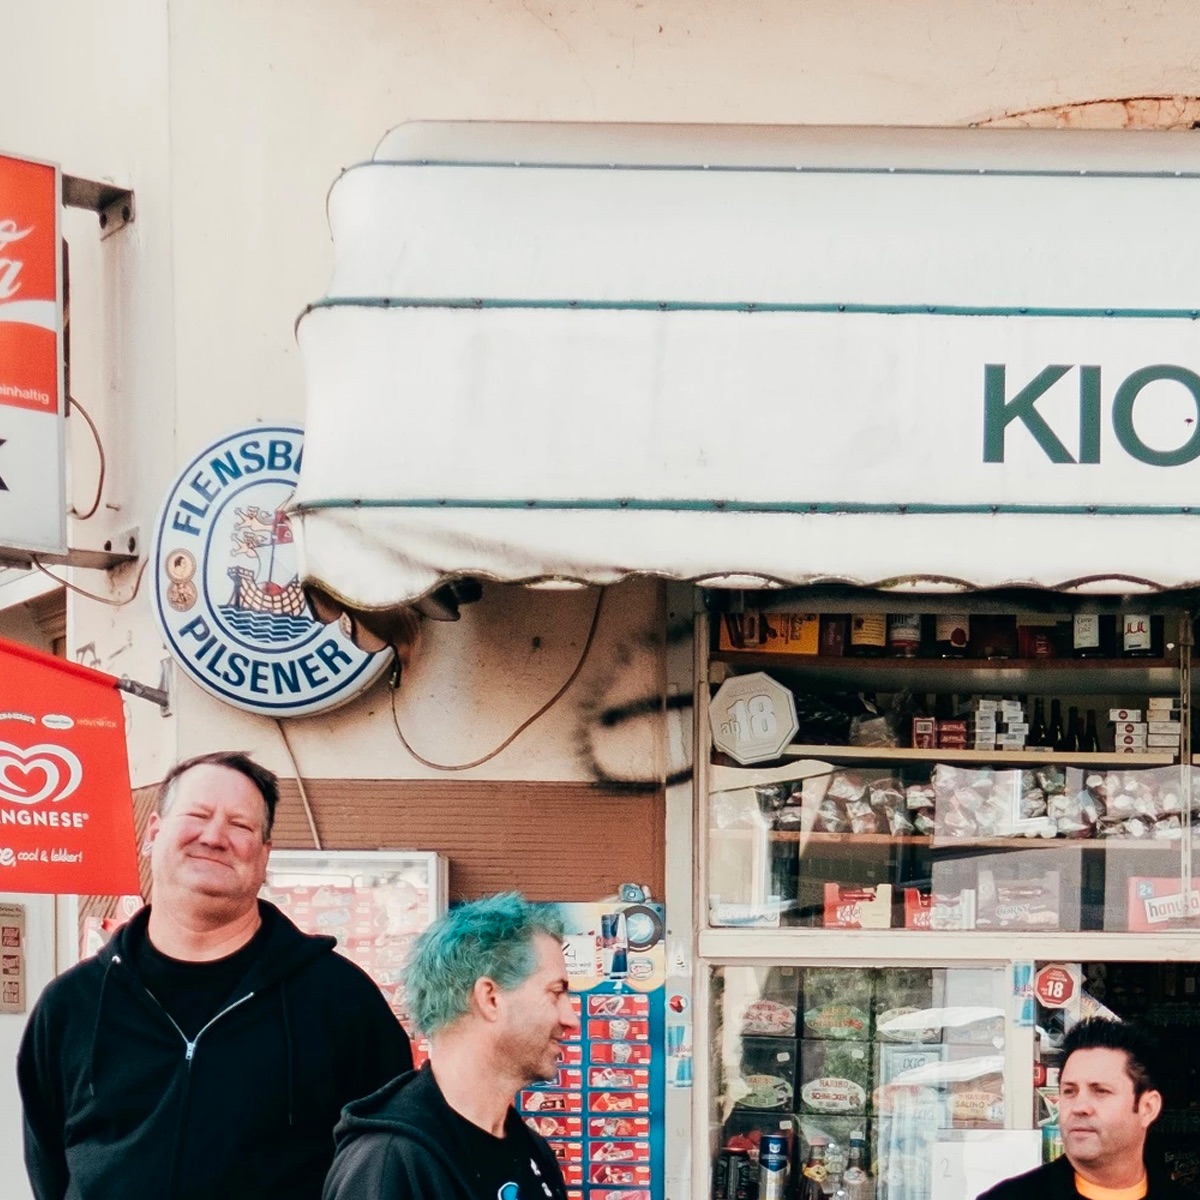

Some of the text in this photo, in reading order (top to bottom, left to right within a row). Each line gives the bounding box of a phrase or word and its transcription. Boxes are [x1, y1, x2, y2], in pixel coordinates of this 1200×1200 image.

[172, 438, 305, 537] FLENSB
[178, 613, 353, 695] PILSENER
[727, 694, 777, 746] 18
[1046, 980, 1064, 998] 18
